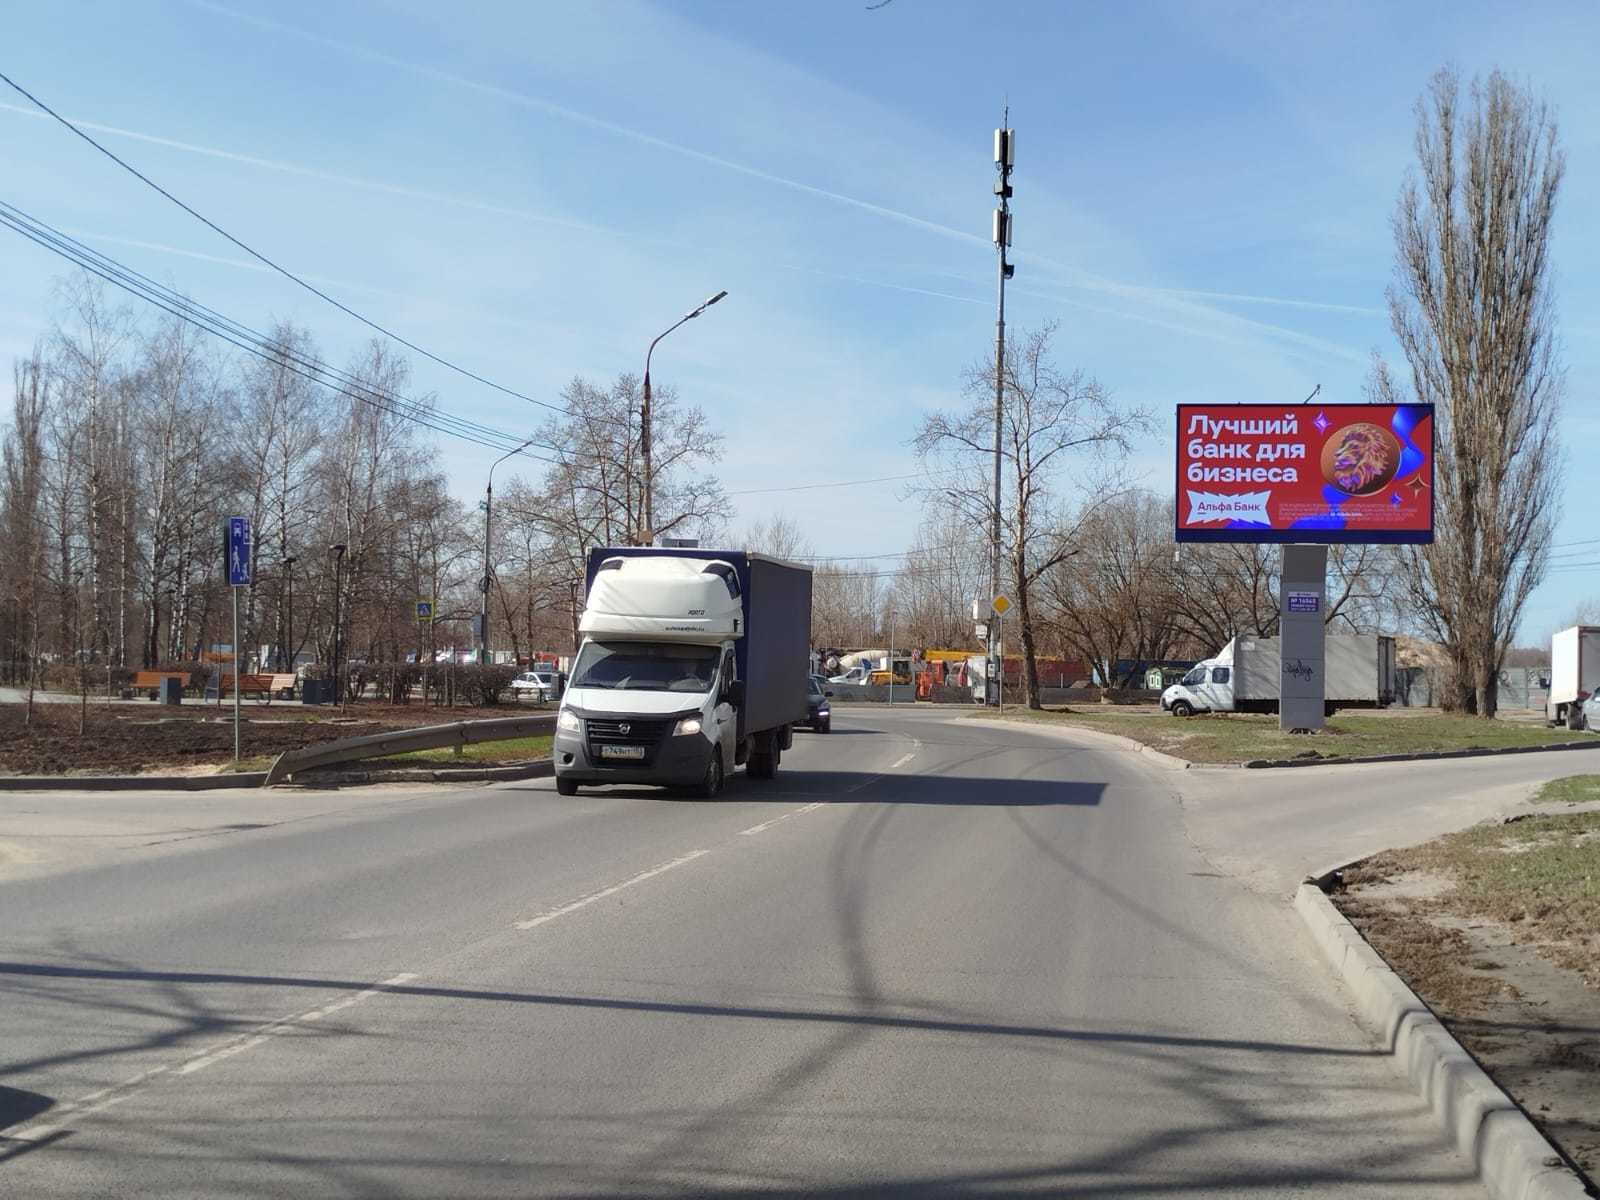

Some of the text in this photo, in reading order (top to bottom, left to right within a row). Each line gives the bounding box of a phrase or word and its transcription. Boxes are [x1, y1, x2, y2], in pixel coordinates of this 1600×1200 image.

[1187, 414, 1298, 439] Лучший
[1187, 438, 1306, 462] банк для
[1187, 462, 1298, 482] бизнеса
[1198, 501, 1261, 514] Альфа Банк
